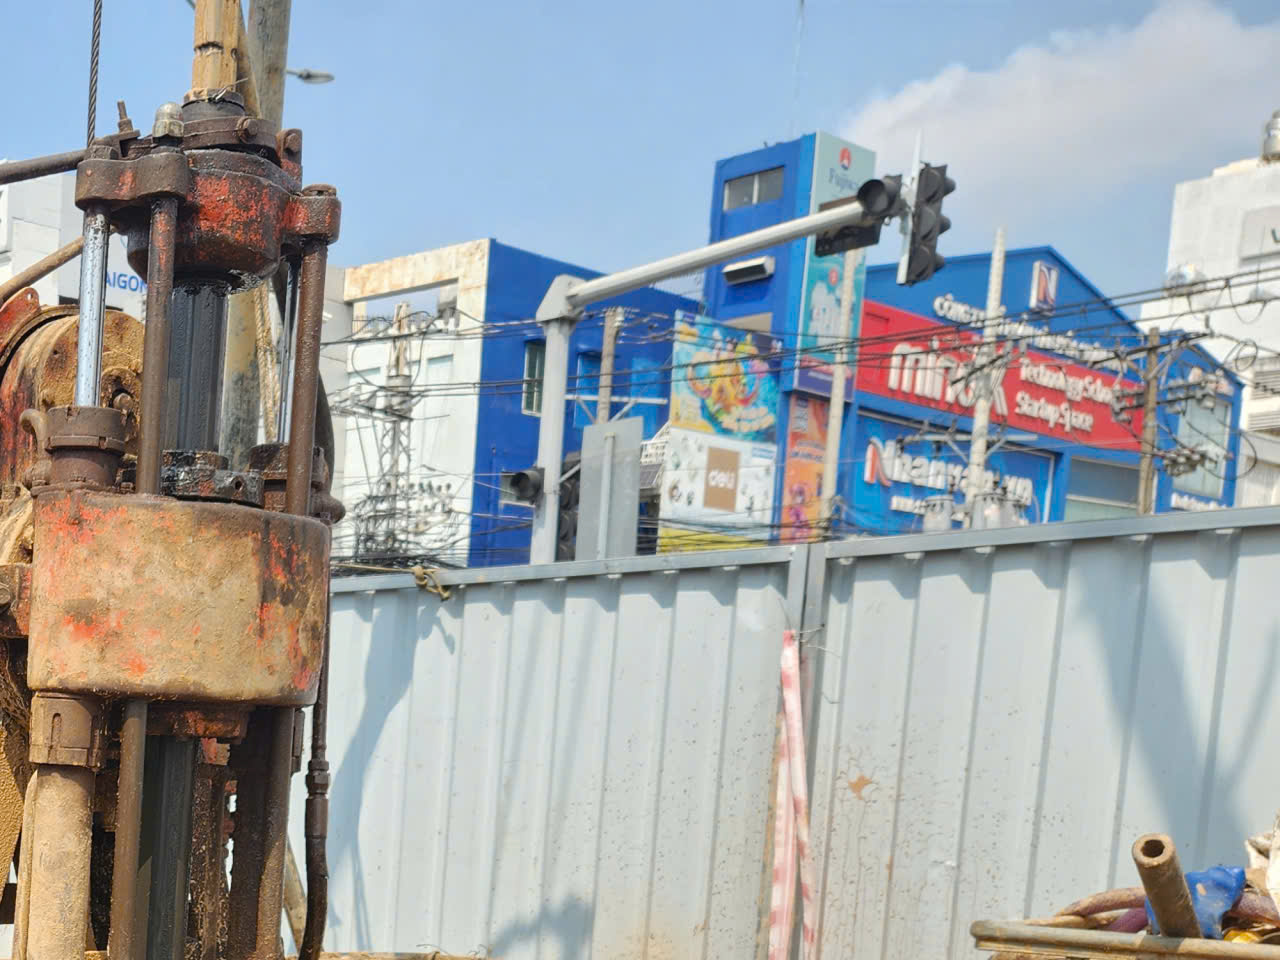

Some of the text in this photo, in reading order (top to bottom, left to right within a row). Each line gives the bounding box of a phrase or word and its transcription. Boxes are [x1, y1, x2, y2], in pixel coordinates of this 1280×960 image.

[106, 271, 148, 293] AIGON
[1019, 356, 1121, 406] Technology Scho
[1015, 391, 1093, 431] Startup Space
